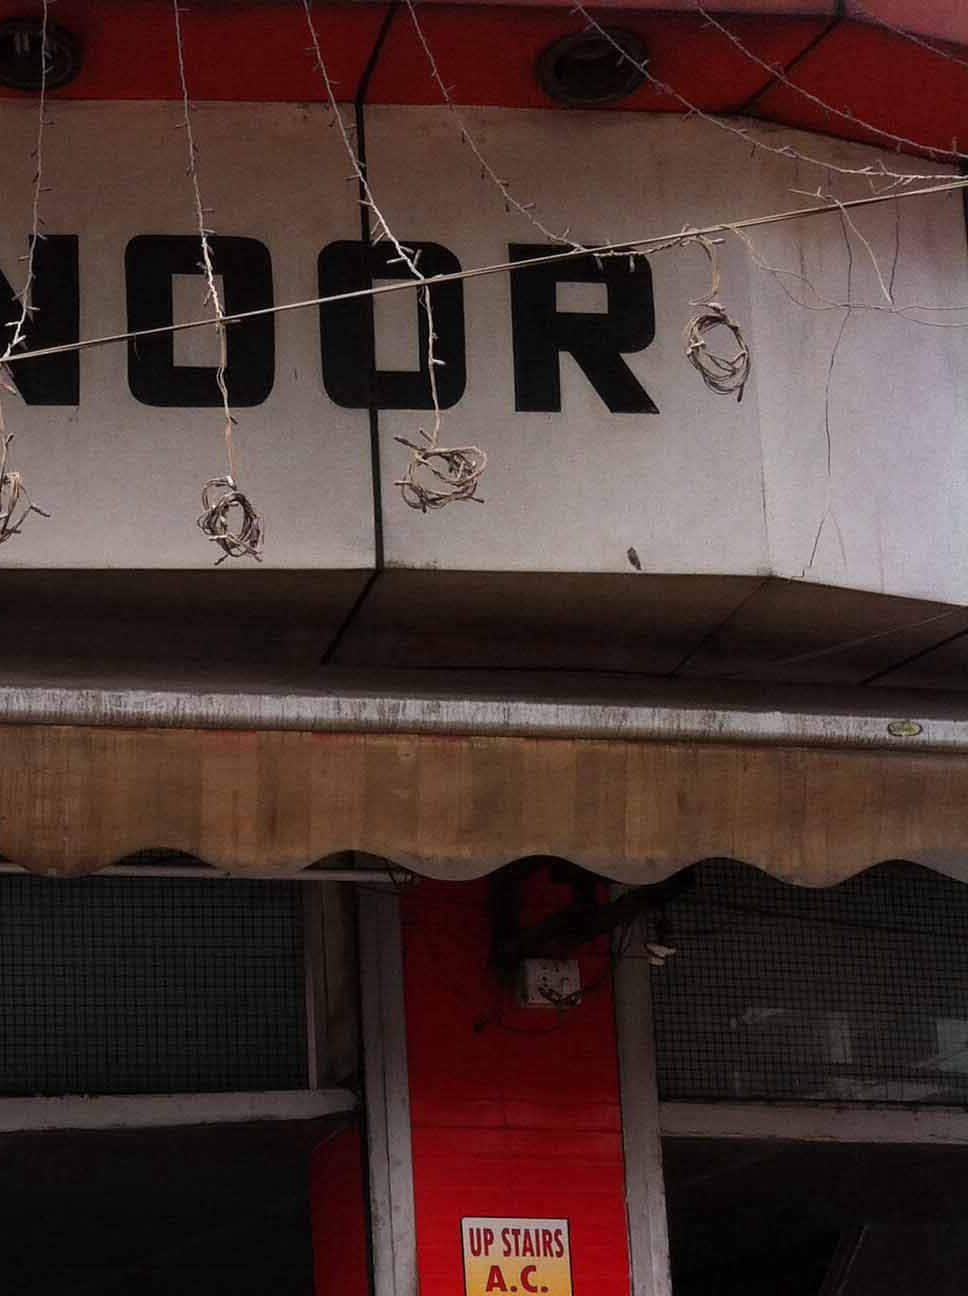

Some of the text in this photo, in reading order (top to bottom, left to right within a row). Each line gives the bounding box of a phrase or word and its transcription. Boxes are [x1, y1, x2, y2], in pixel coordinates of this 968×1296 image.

[469, 1228, 565, 1258] UP STAIRS
[486, 1265, 549, 1293] A.C.
